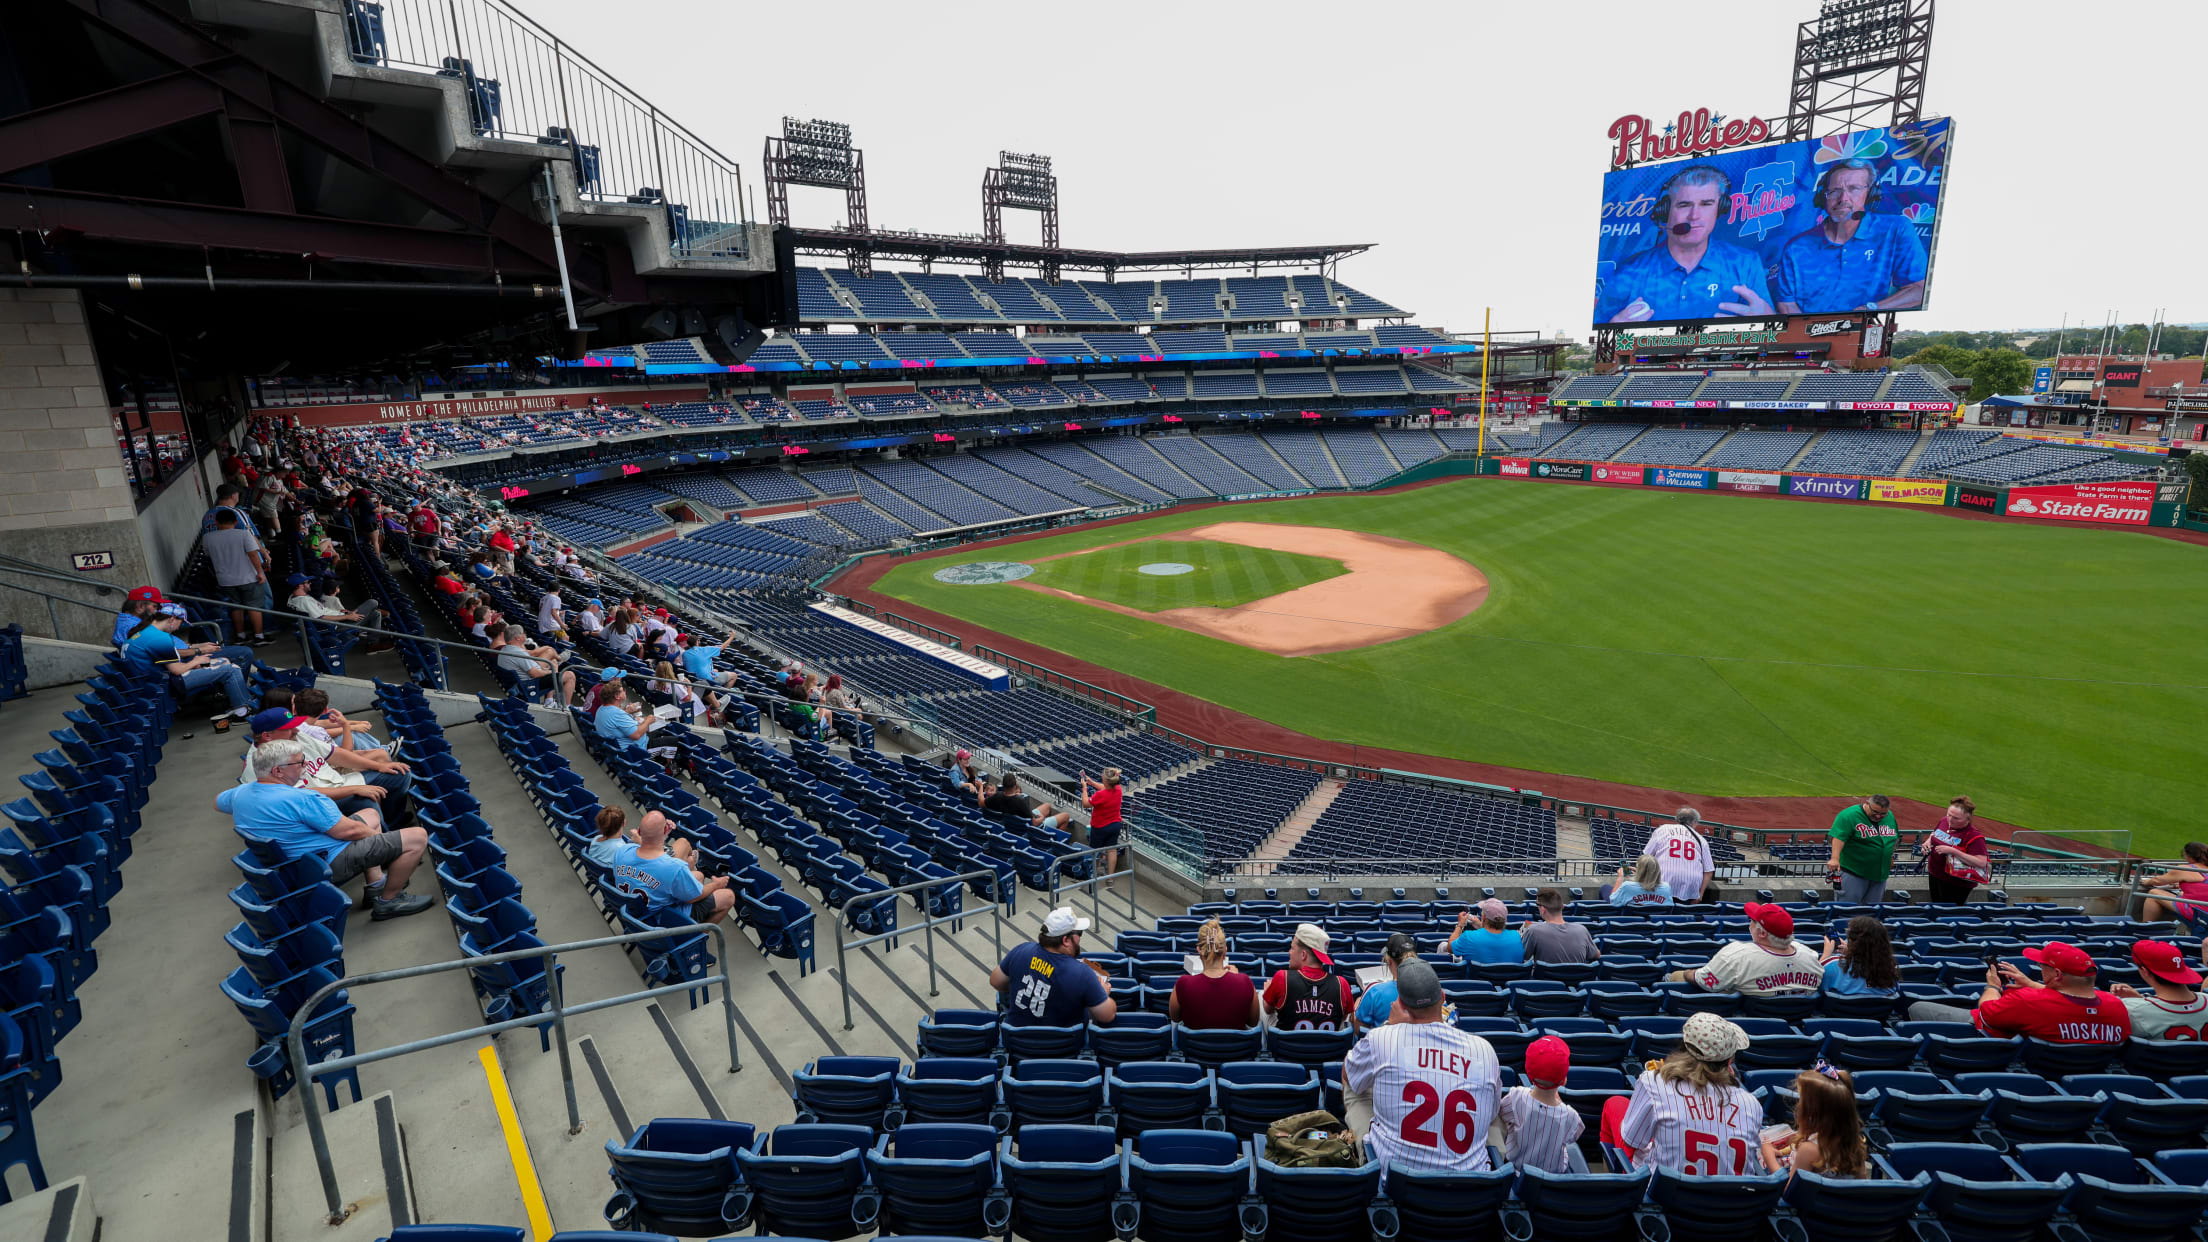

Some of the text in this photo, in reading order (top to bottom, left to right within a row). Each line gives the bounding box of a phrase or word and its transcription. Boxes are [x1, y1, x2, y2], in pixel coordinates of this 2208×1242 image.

[1607, 107, 1769, 166] Phillies
[1727, 189, 1796, 225] Phillies
[1599, 222, 1641, 237] PHIA
[1809, 319, 1845, 337] GHOST
[1637, 333, 1696, 348] Citizens
[1699, 331, 1739, 346] Bank
[1741, 329, 1778, 344] Park
[2105, 372, 2139, 381] GIANT
[380, 397, 557, 419] HOME OF THE PHILADELPHIA PHILLIES
[1855, 402, 1892, 410] TOYOTA
[1912, 402, 1950, 410] TOYOTA
[1501, 464, 1528, 475] Wawa
[1551, 465, 1583, 474] NovaCare
[1667, 471, 1703, 479] SHERWIN
[501, 486, 529, 500] Phillies
[1794, 478, 1855, 496] xfinity
[1960, 493, 1996, 507] GIANT
[82, 555, 104, 566] 212
[1669, 838, 1695, 861] 26
[616, 864, 660, 890] REALMUTO
[1632, 893, 1666, 904] SCHMIDT
[1030, 956, 1055, 978] BOHM
[2172, 956, 2182, 968] P
[1755, 972, 1818, 991] SCHWARBER
[1295, 999, 1334, 1016] JAMES
[2059, 1022, 2122, 1042] HOSKINS
[1418, 1047, 1472, 1079] UTLEY
[1400, 1080, 1477, 1155] 26
[1686, 1094, 1739, 1128] RUIZ
[1684, 1129, 1747, 1176] 51
